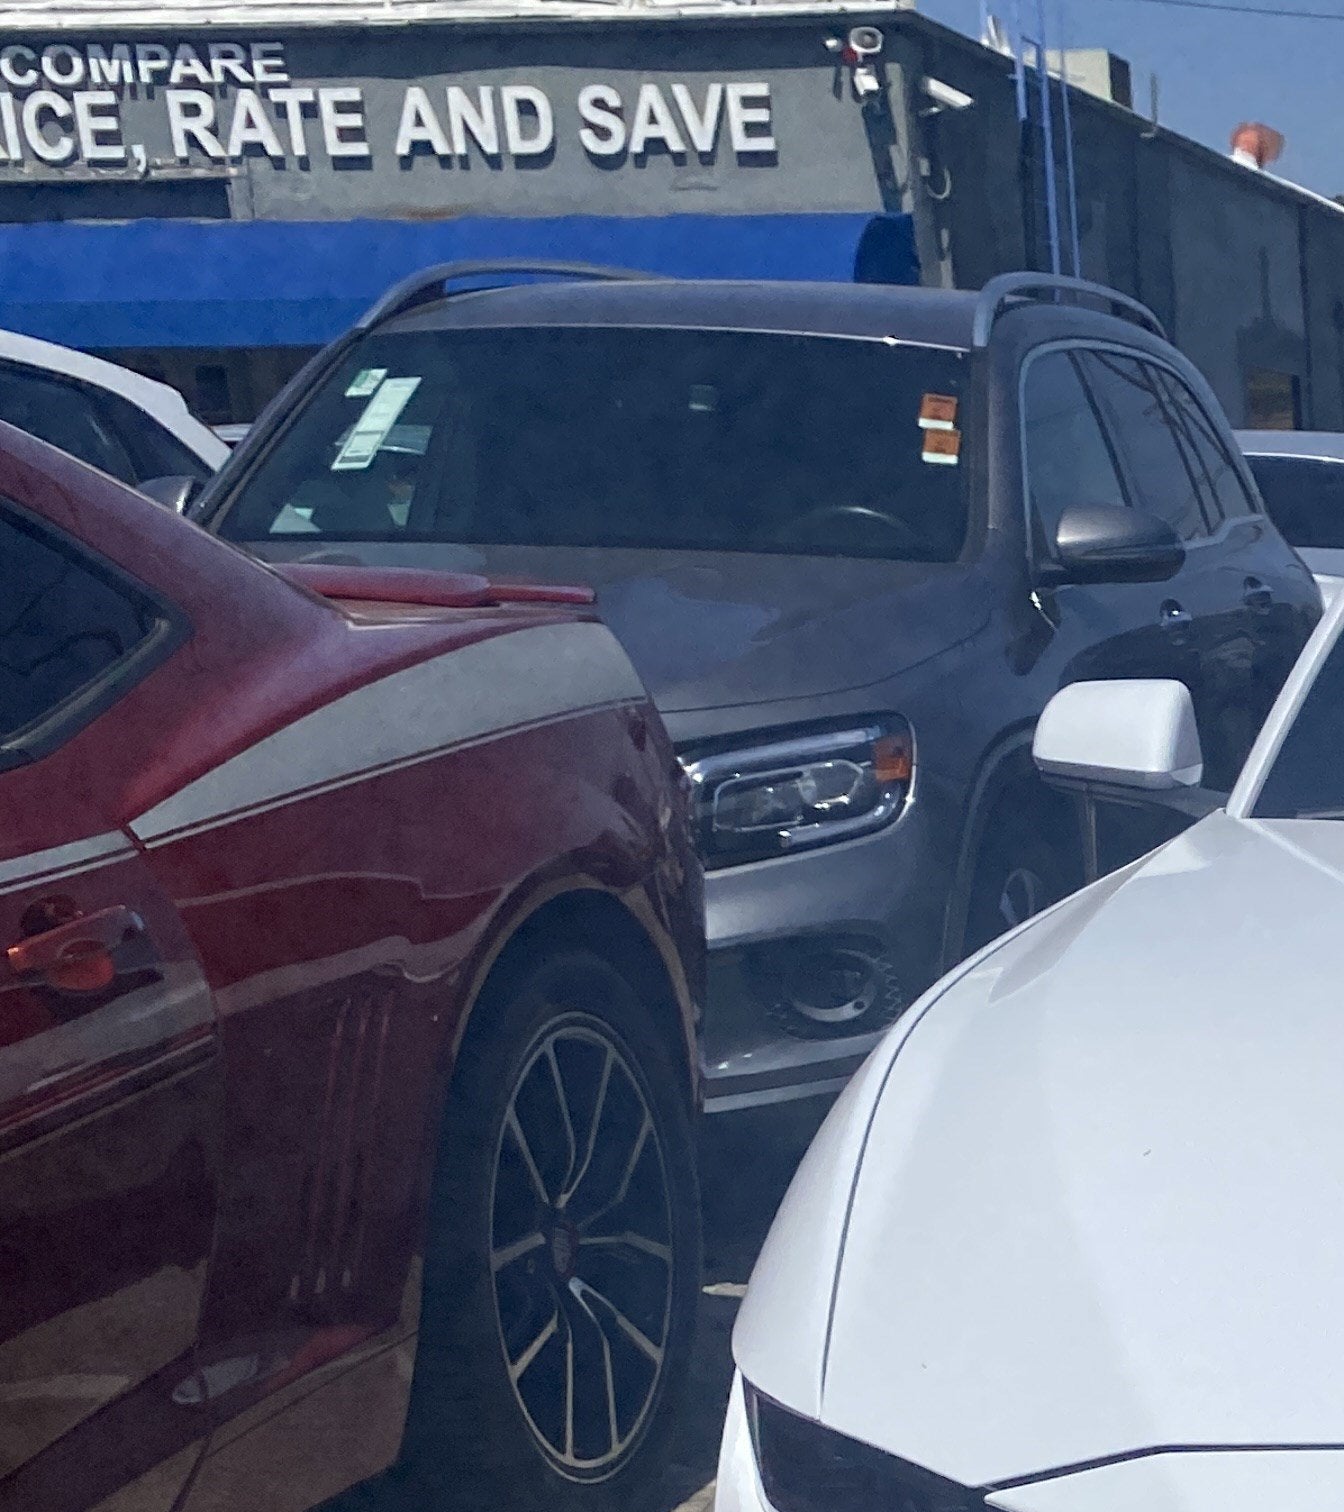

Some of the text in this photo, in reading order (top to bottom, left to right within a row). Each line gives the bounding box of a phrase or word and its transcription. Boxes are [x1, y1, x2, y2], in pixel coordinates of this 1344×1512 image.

[0, 42, 290, 86] COMPARE
[0, 82, 777, 173] ICE, RATE AND SAVE
